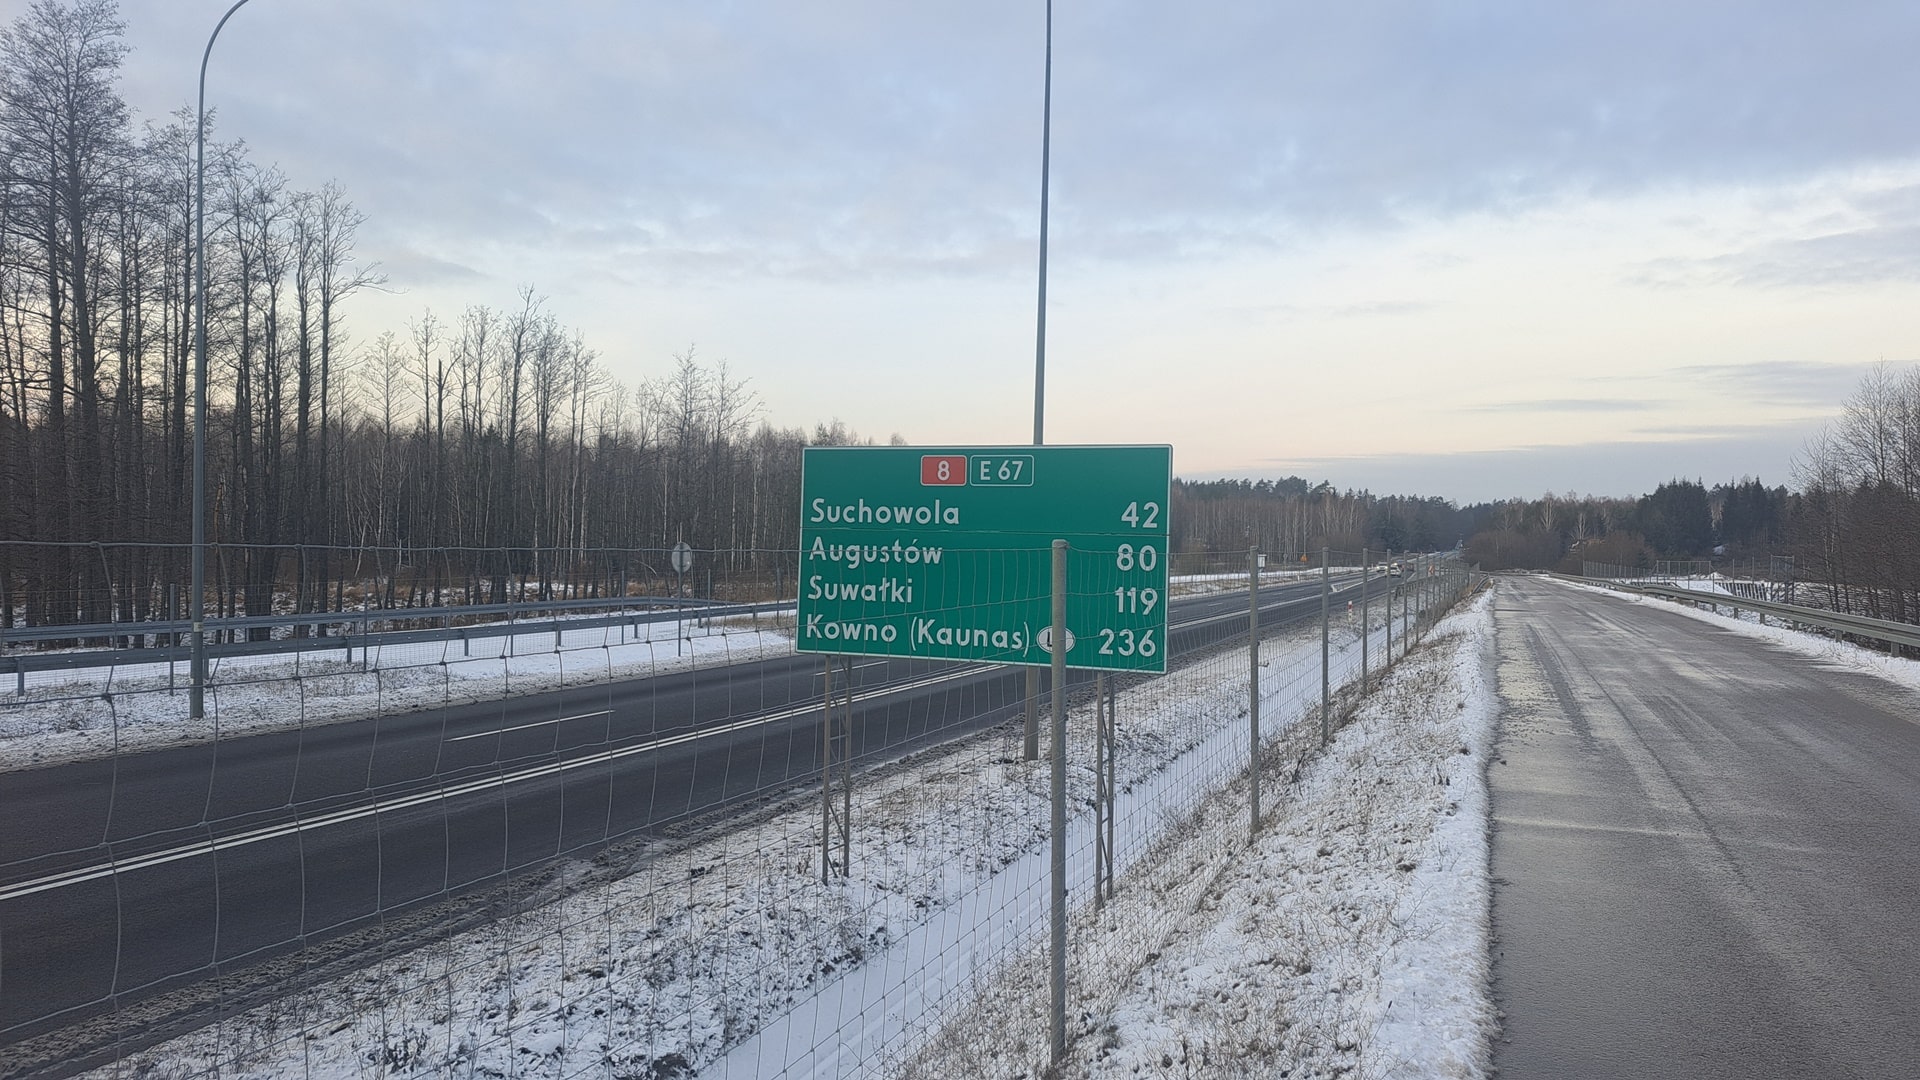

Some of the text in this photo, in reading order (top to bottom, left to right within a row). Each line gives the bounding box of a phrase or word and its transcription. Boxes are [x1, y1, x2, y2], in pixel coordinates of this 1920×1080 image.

[937, 461, 950, 481] 8
[980, 461, 1023, 481] E 67
[810, 498, 1159, 528] Suchowola 42
[809, 537, 1157, 571] Augustów 80
[807, 575, 1157, 615] Suwałki 119
[806, 614, 897, 642] Kowno
[910, 617, 1029, 657] (Kaunas)
[1099, 629, 1155, 657] 236
